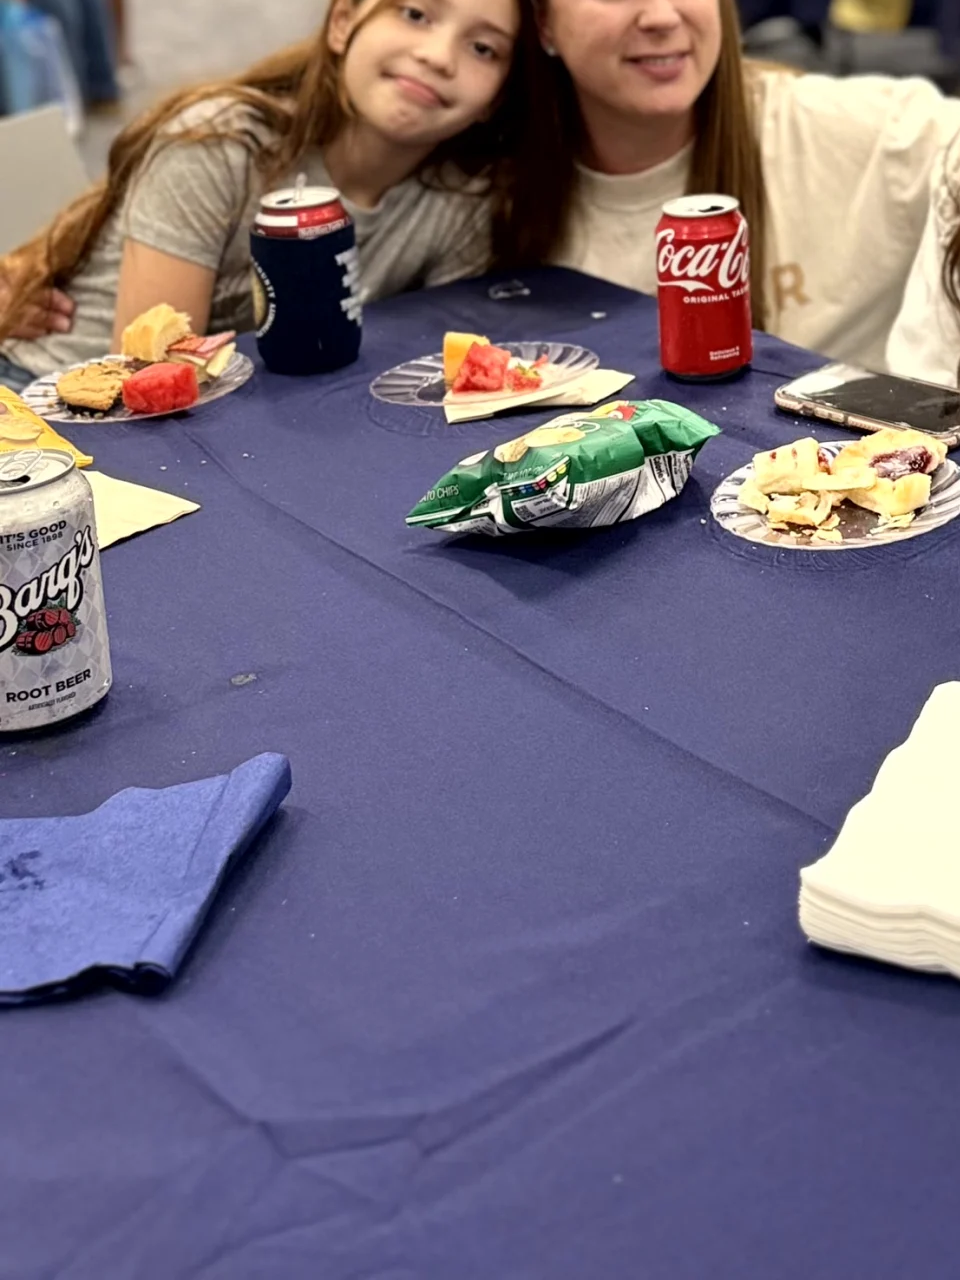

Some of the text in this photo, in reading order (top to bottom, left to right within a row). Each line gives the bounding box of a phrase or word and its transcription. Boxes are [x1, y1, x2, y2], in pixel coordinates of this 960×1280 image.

[656, 218, 750, 289] Coca-Co
[683, 293, 729, 304] ORIGINAL
[436, 483, 459, 499] CHIPS
[0, 520, 67, 545] IT'S GOOD
[6, 531, 63, 552] SINCE 1898
[0, 525, 94, 650] Barq's
[6, 668, 91, 703] ROOT BEER
